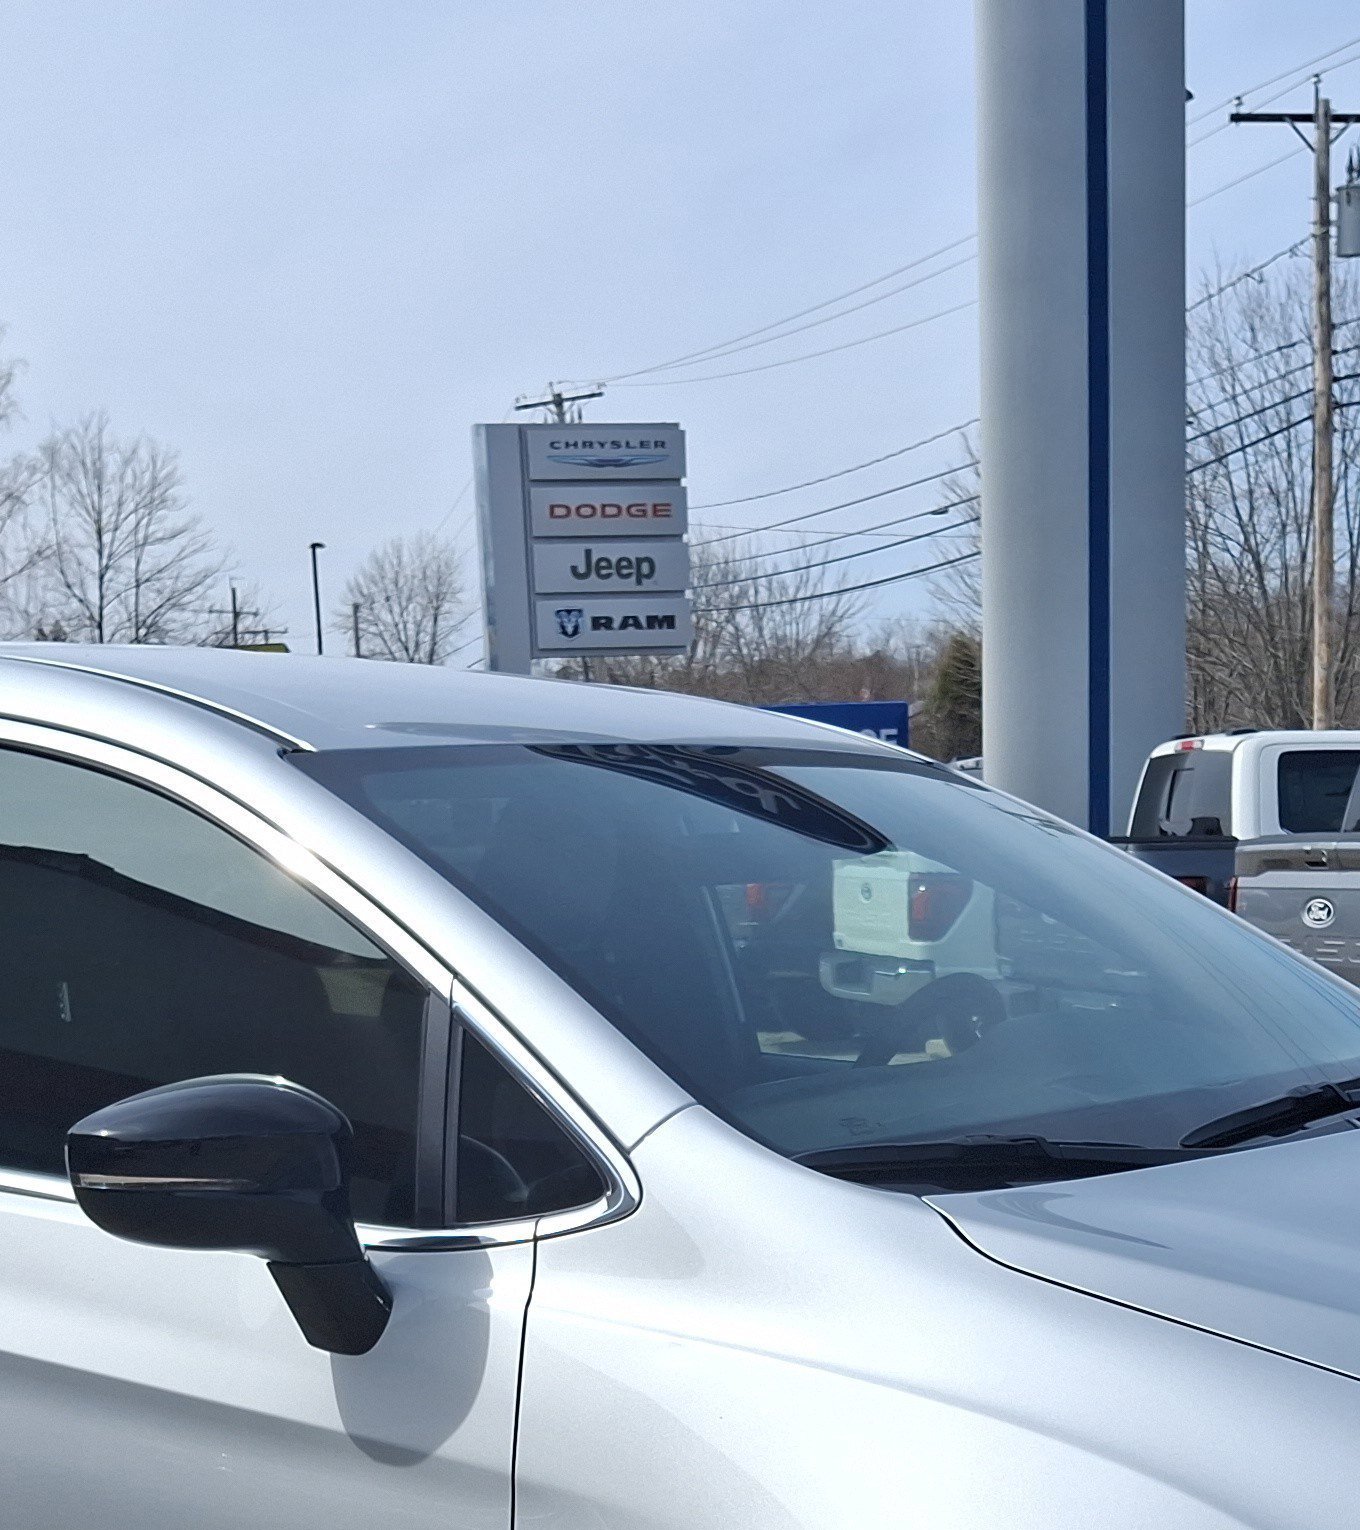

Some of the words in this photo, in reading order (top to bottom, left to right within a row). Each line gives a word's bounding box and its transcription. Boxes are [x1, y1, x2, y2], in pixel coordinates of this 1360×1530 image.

[549, 440, 666, 450] CHRYSLER
[549, 503, 673, 519] DODGE
[570, 549, 656, 586] Jeep
[591, 615, 676, 632] RAM
